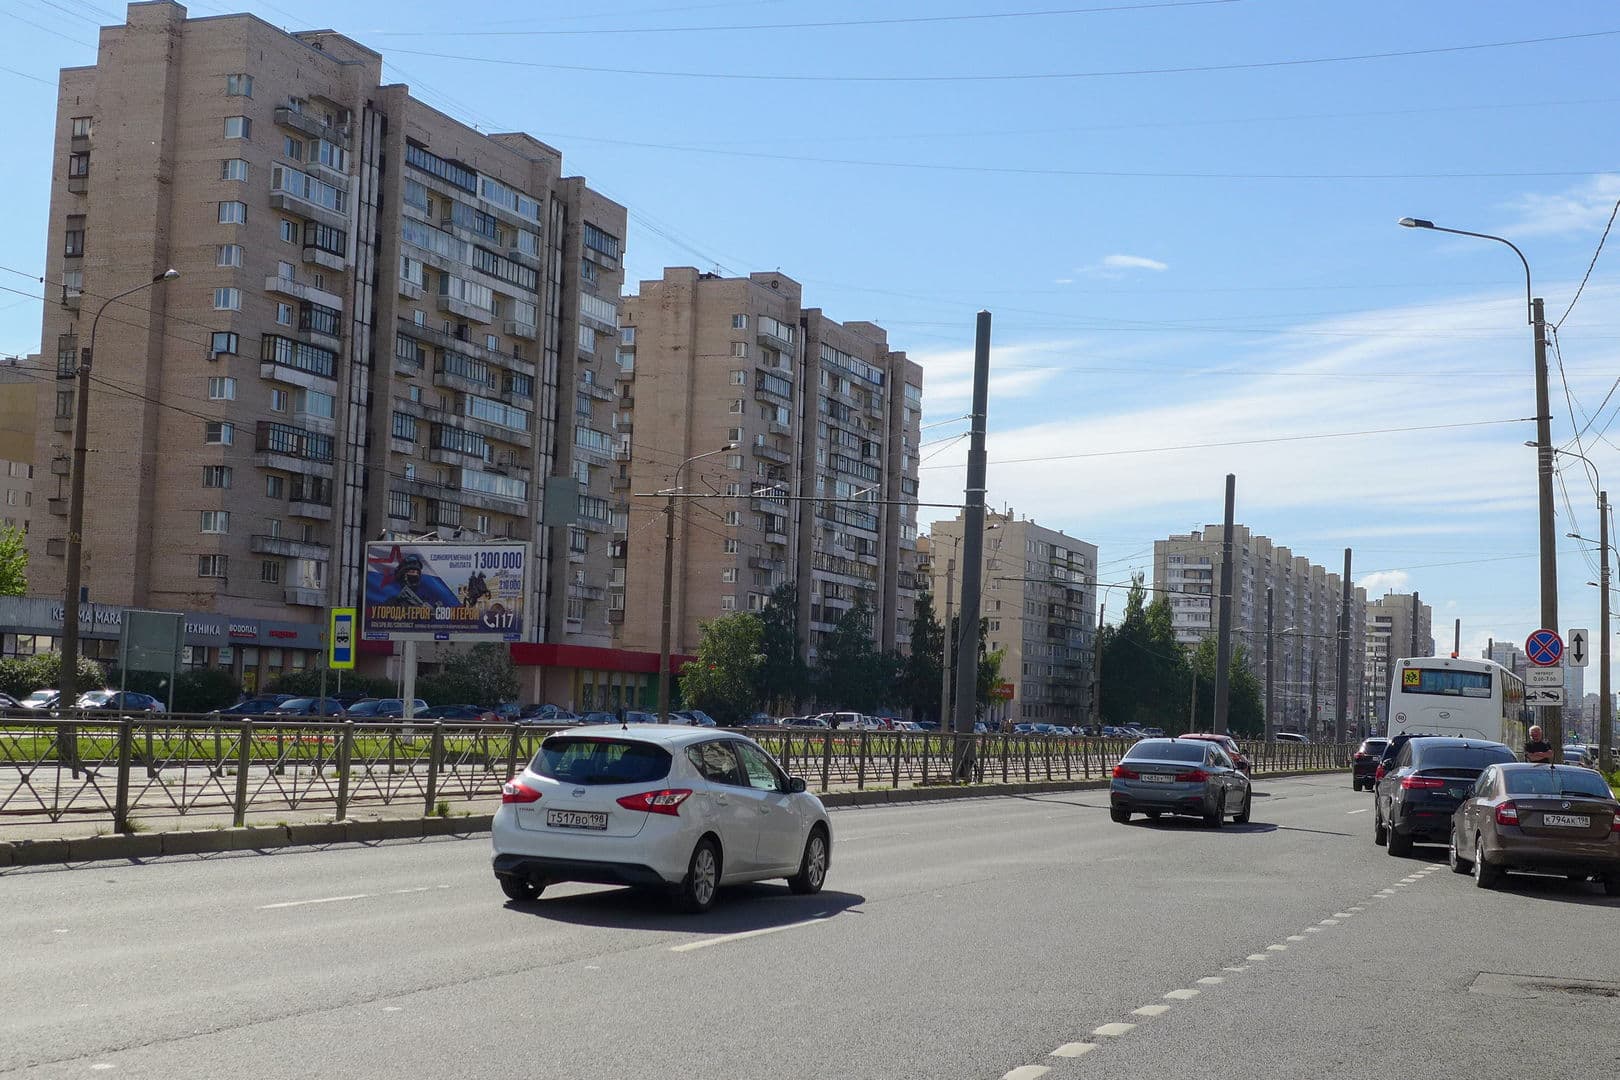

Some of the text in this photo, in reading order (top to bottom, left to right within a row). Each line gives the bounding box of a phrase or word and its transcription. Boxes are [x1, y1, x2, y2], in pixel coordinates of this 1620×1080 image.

[474, 552, 522, 569] 1 300 000
[95, 613, 122, 626] MARA
[494, 613, 514, 629] 117
[184, 622, 221, 636] ТЕХНИКА
